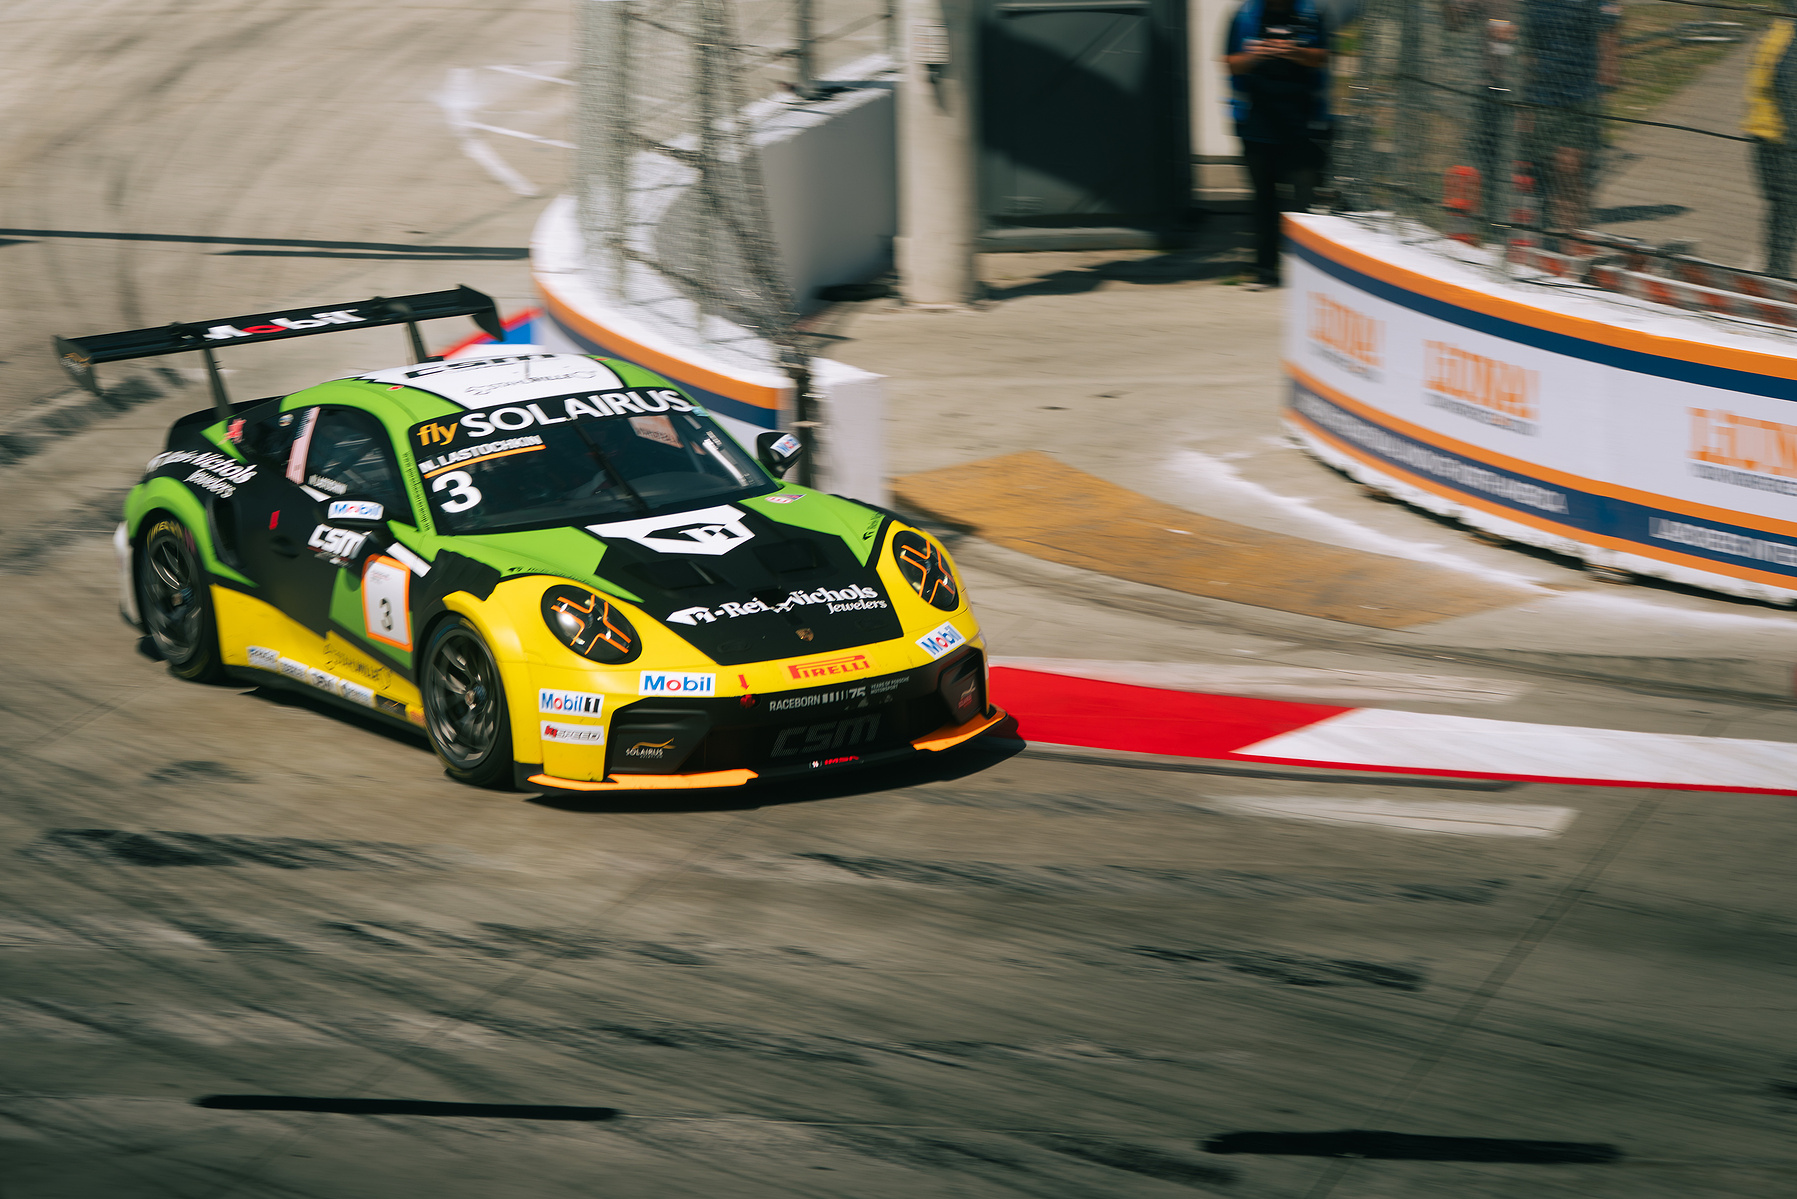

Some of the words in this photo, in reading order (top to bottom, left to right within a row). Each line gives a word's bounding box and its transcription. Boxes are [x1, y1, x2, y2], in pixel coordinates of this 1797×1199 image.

[203, 309, 367, 341] Mobil
[417, 422, 458, 447] fly
[459, 390, 692, 438] SOLAIRUS
[437, 435, 544, 467] LASTOCHKIN
[432, 471, 482, 513] 3
[379, 597, 394, 632] 3
[826, 599, 888, 615] Jewelers
[921, 625, 962, 656] Mobil
[788, 655, 871, 680] PIRELLI
[643, 675, 711, 692] Mobil
[769, 693, 821, 712] RACEBORN
[849, 686, 867, 700] 75
[541, 692, 583, 712] Mobil
